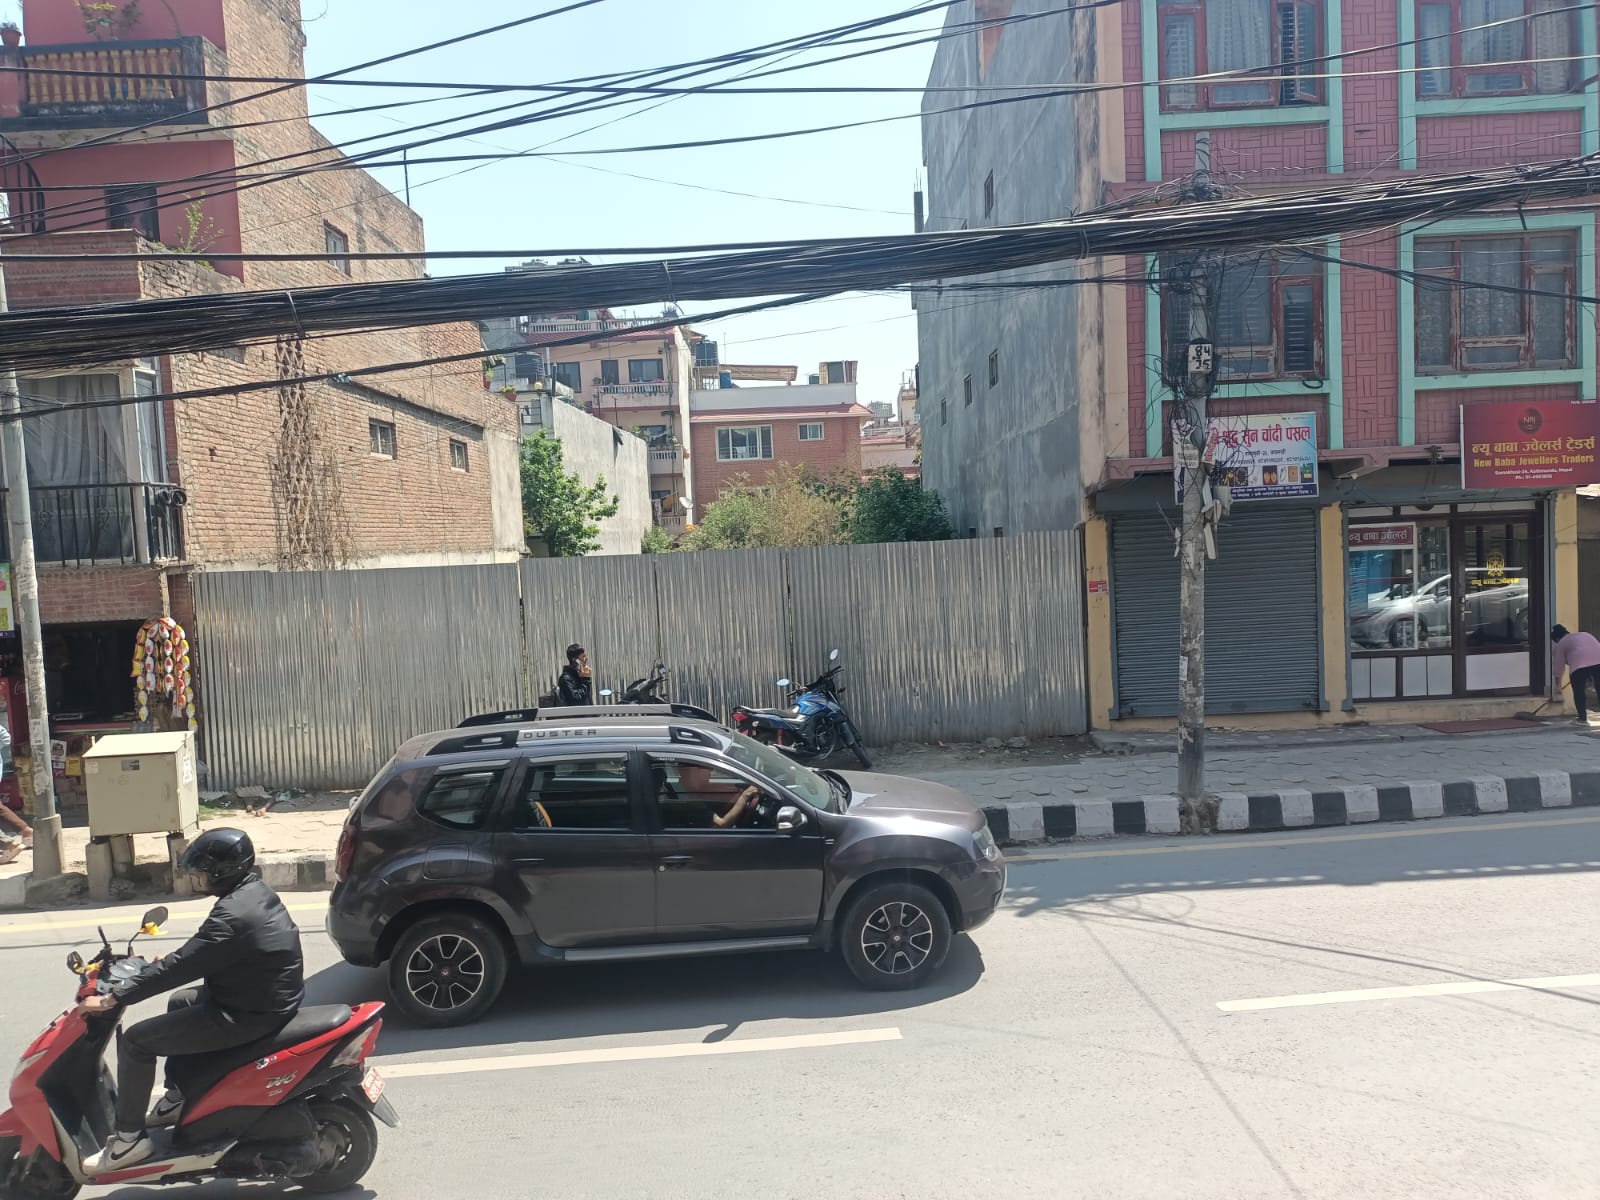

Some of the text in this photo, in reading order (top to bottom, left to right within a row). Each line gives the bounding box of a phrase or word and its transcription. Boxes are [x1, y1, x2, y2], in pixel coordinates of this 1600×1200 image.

[1195, 345, 1210, 357] 84
[1286, 426, 1311, 441] पसल
[1472, 436, 1595, 456] न्यू बाबा ज्वेलर्स ट्रेडर्स
[1474, 454, 1594, 467] New Baba Jewellers Traders
[523, 729, 597, 739] DUSTER
